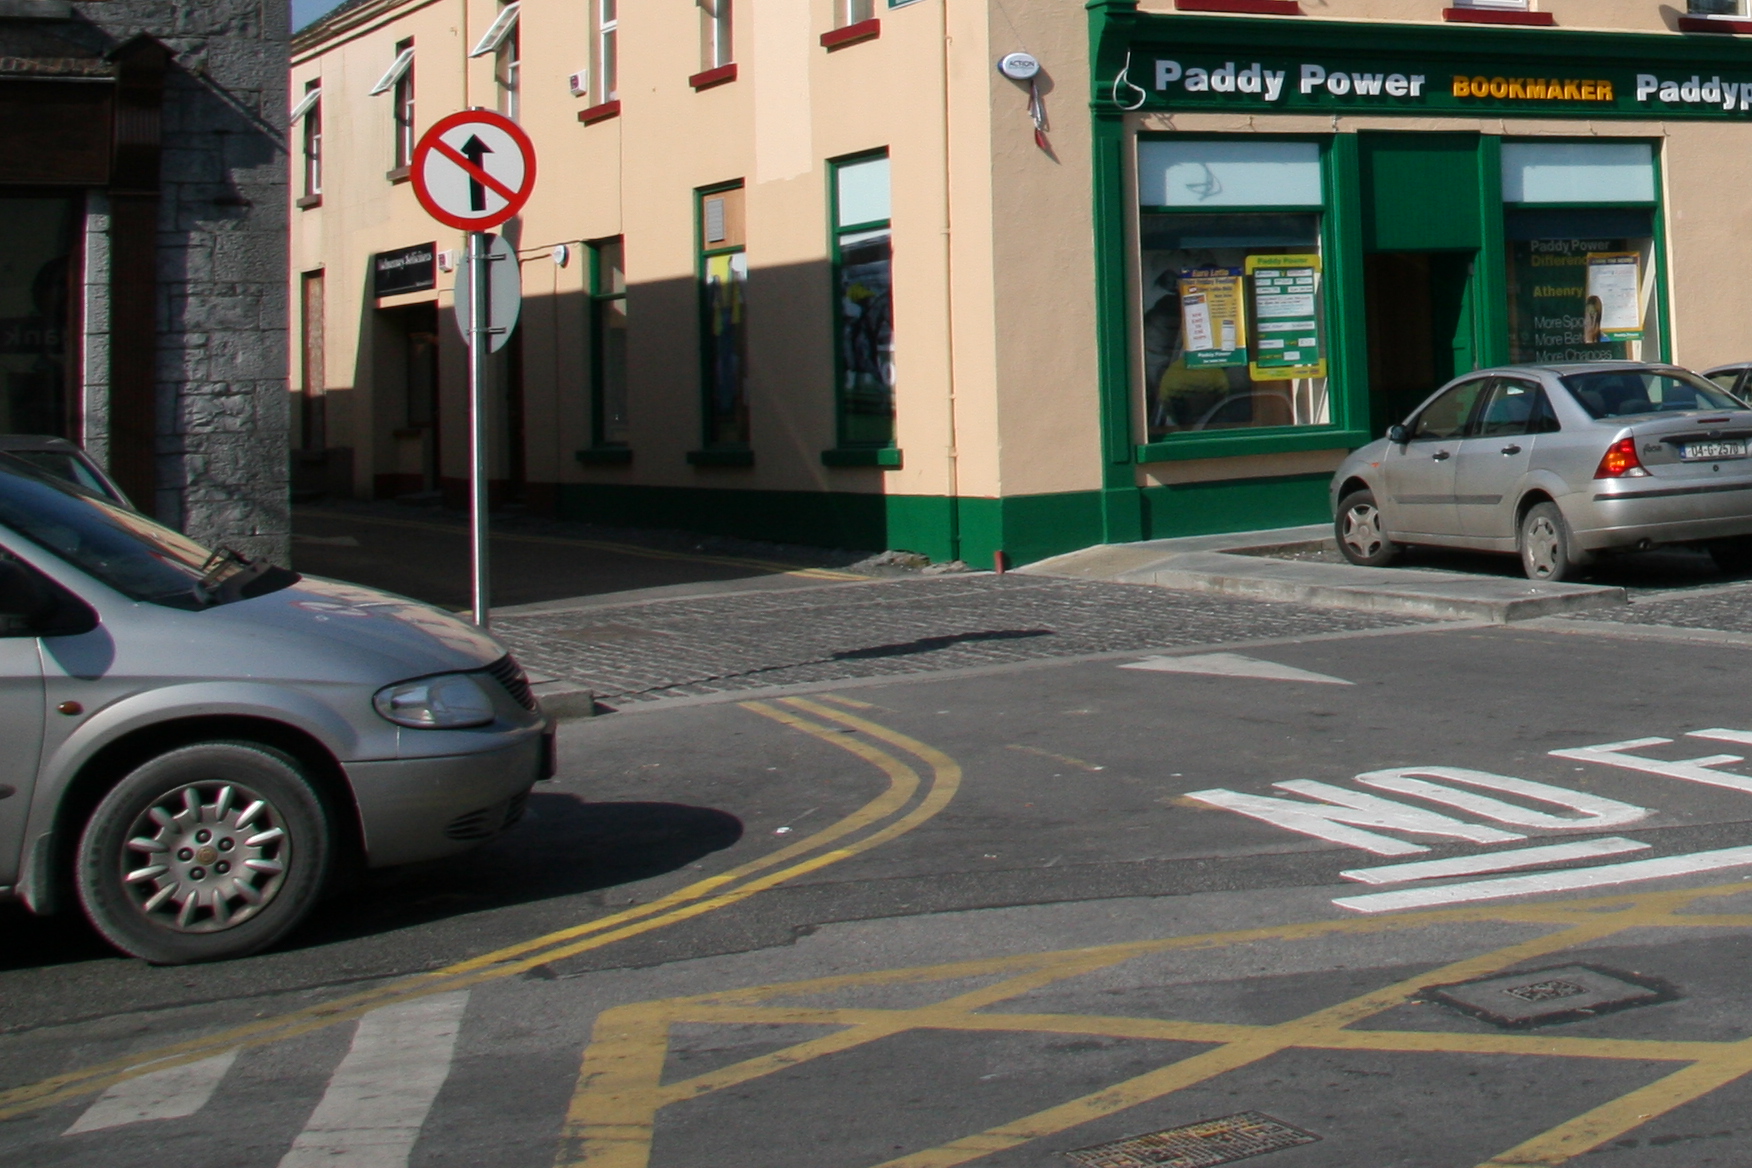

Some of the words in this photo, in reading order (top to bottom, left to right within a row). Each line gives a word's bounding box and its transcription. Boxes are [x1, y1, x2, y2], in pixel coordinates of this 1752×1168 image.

[1009, 60, 1035, 68] ACTION
[1155, 59, 1286, 101] Paddy
[1300, 64, 1426, 97] Power
[1452, 75, 1614, 102] BOOKMAKER
[1531, 240, 1571, 256] Paddy
[1571, 240, 1610, 252] Power
[1531, 255, 1587, 267] Differenc
[1533, 285, 1583, 298] Athenry
[1534, 316, 1562, 329] More
[1562, 315, 1585, 330] Spo
[1535, 333, 1563, 346] More
[1564, 332, 1584, 345] Bet
[1536, 350, 1564, 363] More
[1564, 349, 1613, 361] Chances
[1691, 442, 1739, 458] 04-G-2570
[1184, 763, 1659, 855] NO
